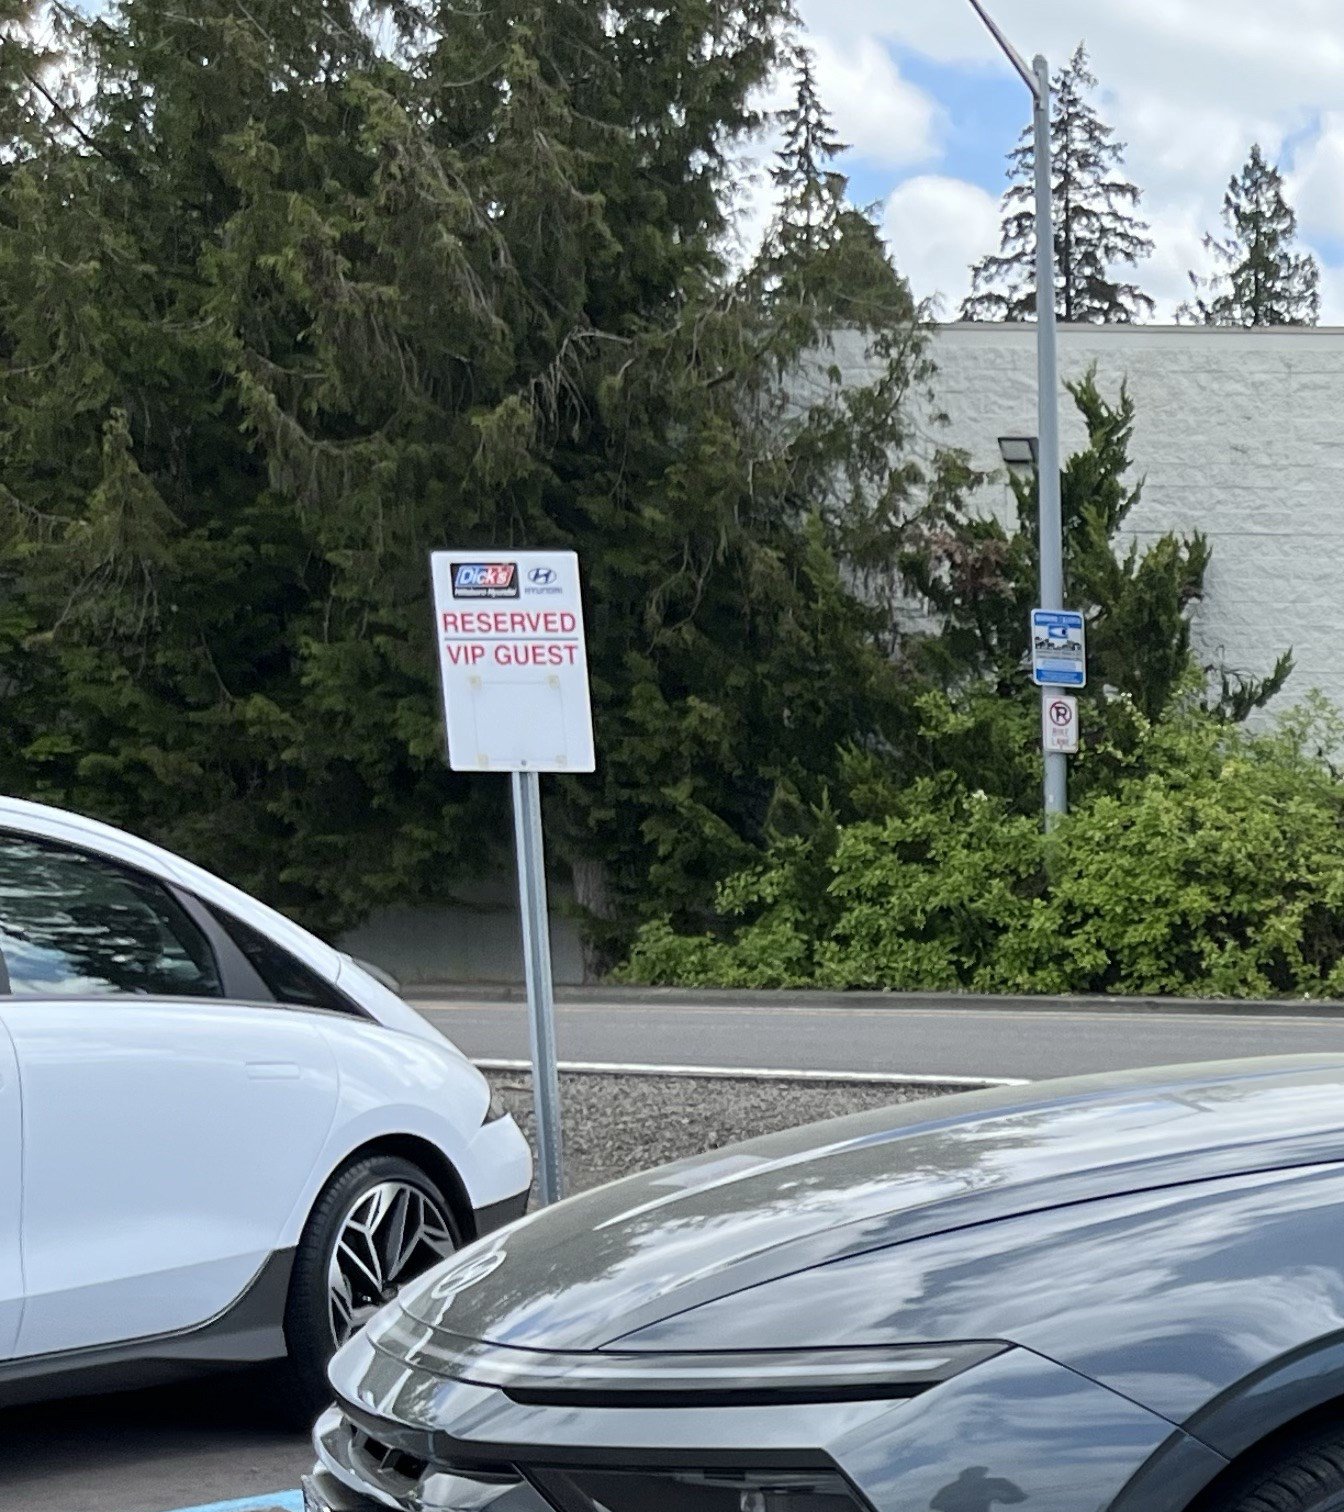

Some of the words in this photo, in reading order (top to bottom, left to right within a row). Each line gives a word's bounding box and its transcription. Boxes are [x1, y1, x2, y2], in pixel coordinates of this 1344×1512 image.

[443, 612, 576, 633] RESERVED
[446, 644, 485, 665] VIP
[494, 644, 579, 665] GUEST
